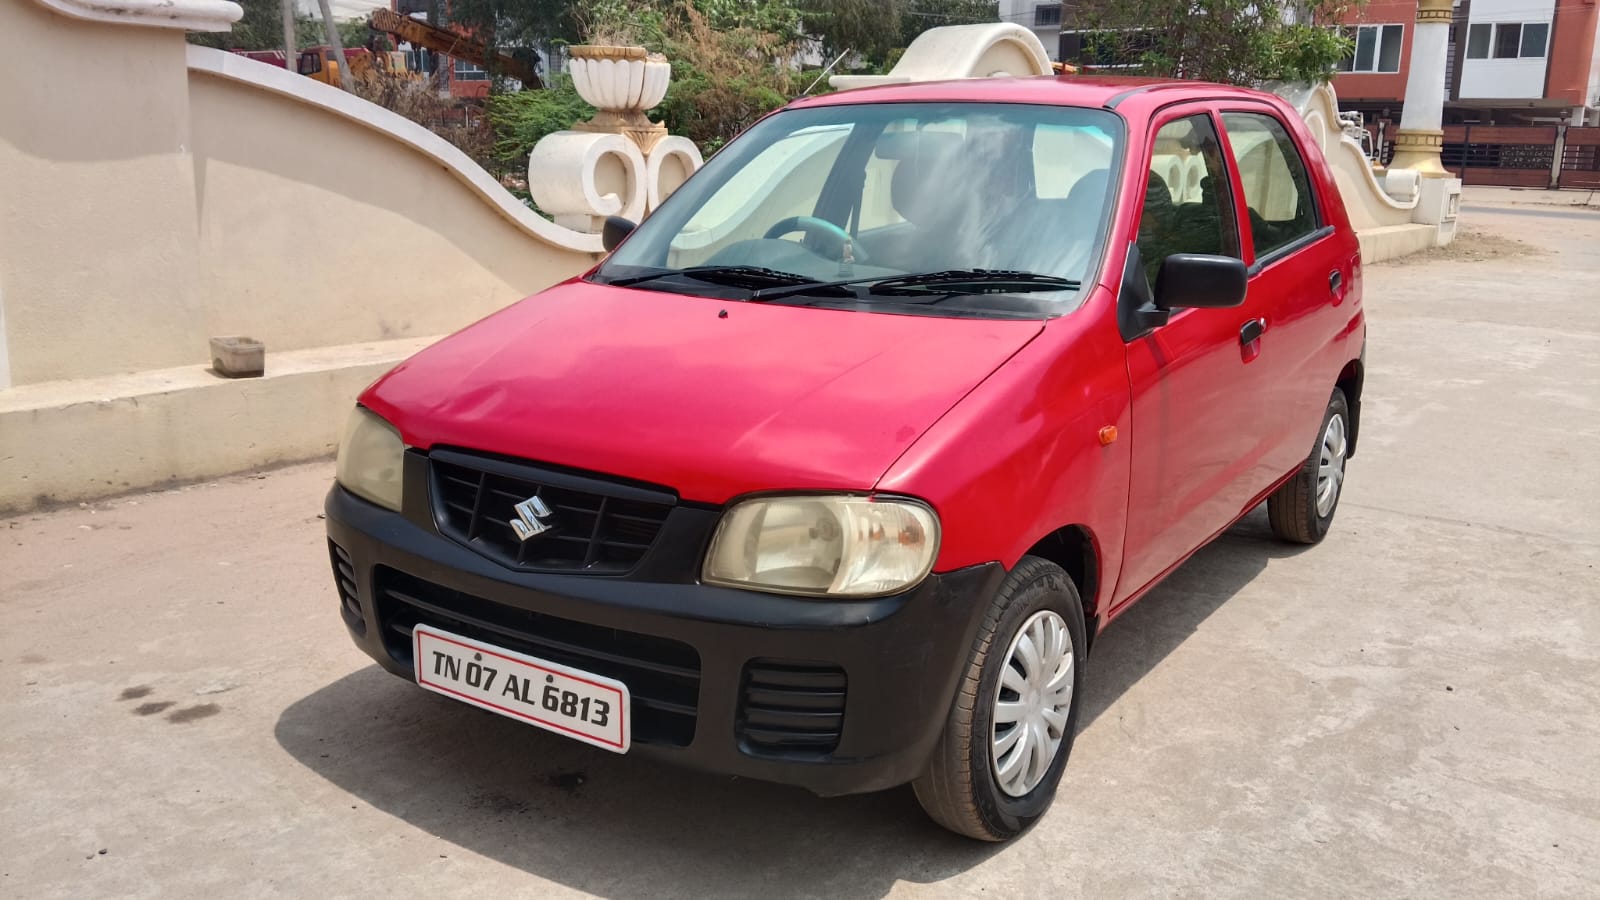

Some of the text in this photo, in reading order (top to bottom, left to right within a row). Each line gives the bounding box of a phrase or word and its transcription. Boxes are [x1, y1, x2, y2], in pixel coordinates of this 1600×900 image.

[433, 651, 610, 727] TN 07 AL 6813
